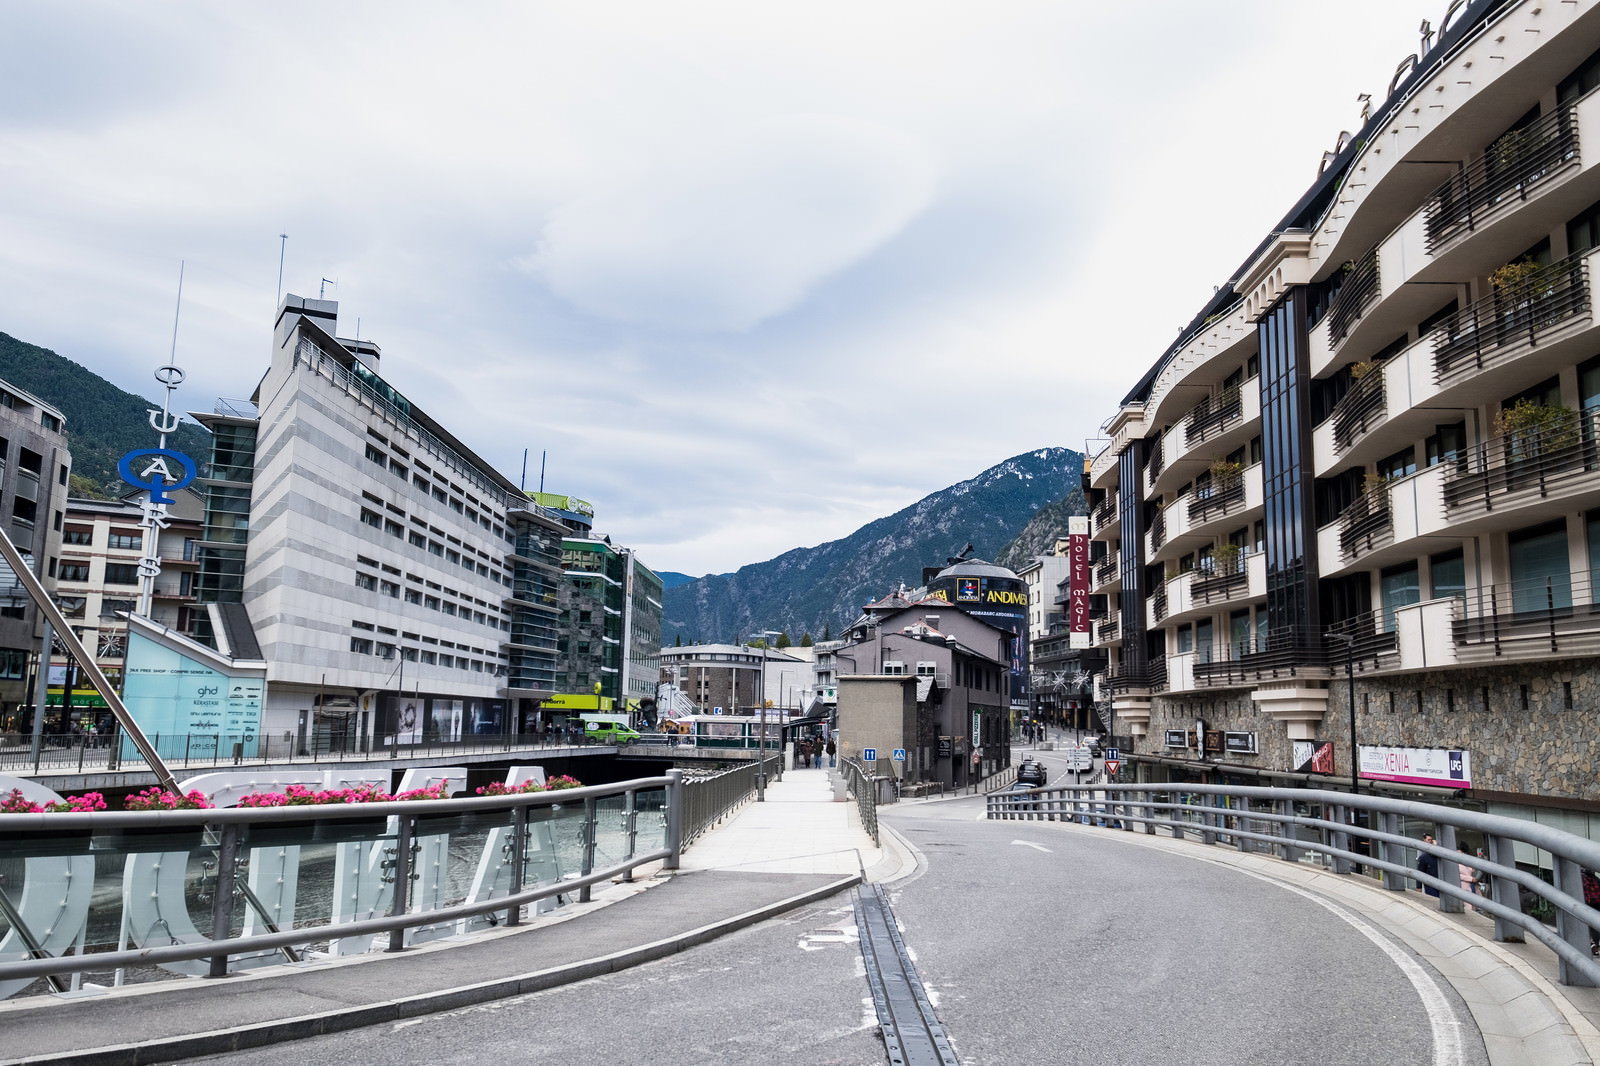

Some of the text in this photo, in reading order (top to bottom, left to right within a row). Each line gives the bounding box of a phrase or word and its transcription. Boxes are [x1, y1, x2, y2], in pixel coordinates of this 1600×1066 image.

[197, 685, 219, 698] ghd
[1384, 753, 1410, 773] XENIA
[1450, 759, 1462, 771] LPG
